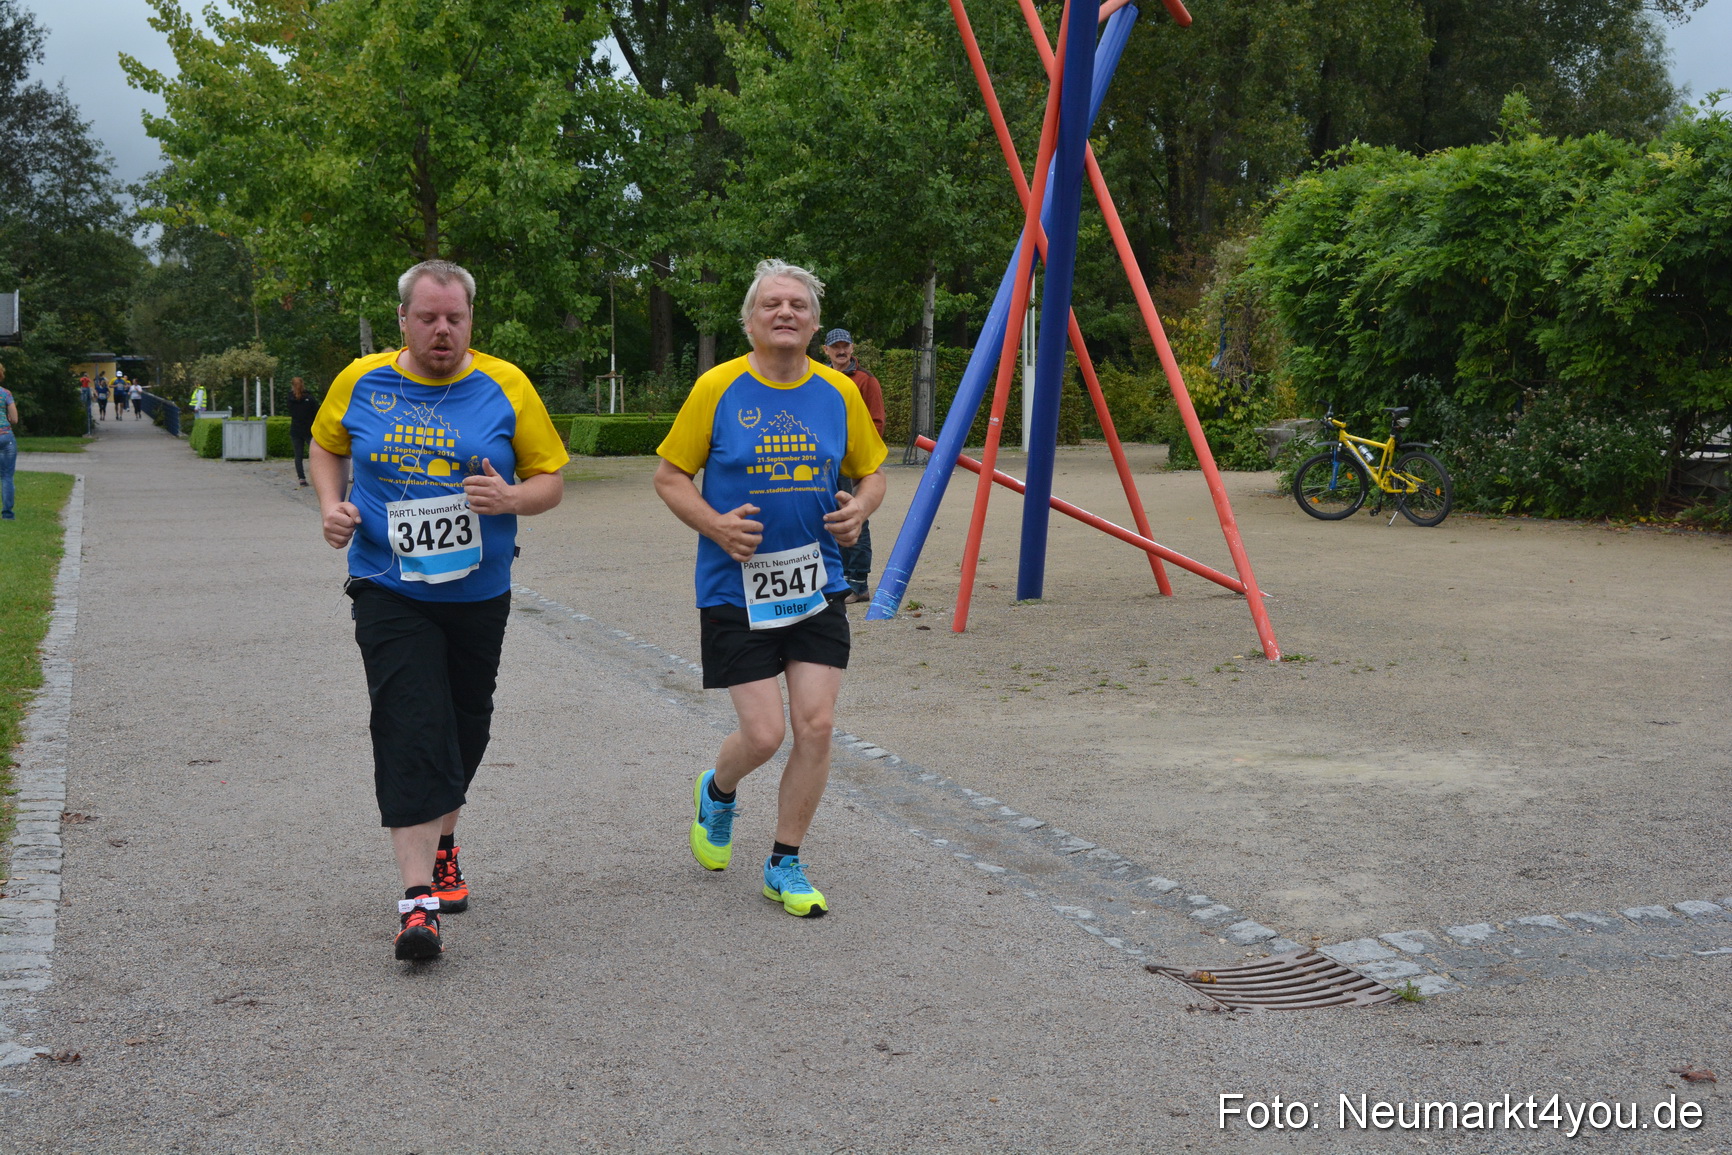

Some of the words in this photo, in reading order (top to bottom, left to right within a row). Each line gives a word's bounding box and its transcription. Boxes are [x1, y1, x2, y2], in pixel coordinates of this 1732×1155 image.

[389, 508, 416, 518] PARTL
[418, 503, 462, 515] Neumarkt
[397, 514, 473, 553] 3423
[743, 561, 771, 570] PARTL
[772, 554, 811, 567] Neumarkt
[752, 563, 818, 600] 2547
[774, 603, 808, 616] Dieter
